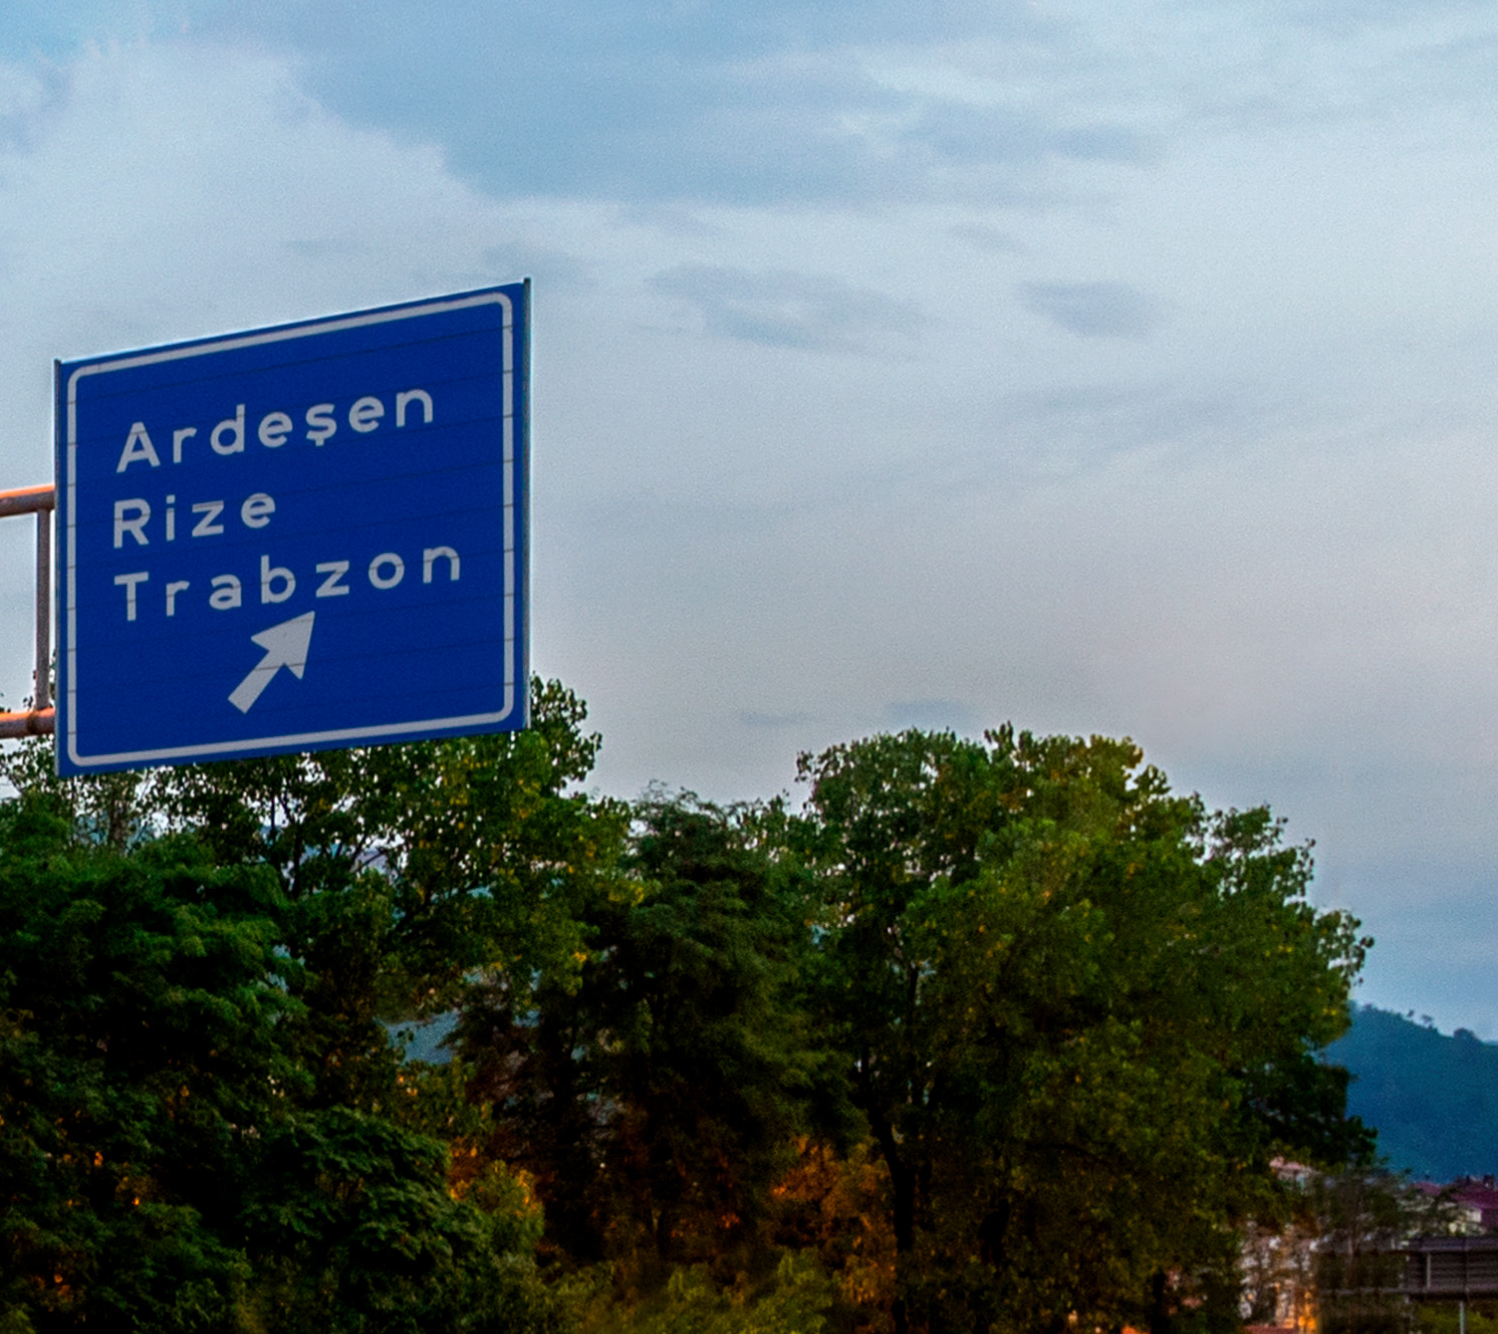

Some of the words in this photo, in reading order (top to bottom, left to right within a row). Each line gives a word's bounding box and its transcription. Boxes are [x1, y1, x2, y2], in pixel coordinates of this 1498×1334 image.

[115, 388, 434, 474] Ardeşen
[113, 492, 276, 549] Rize
[113, 545, 461, 622] Trabzon
